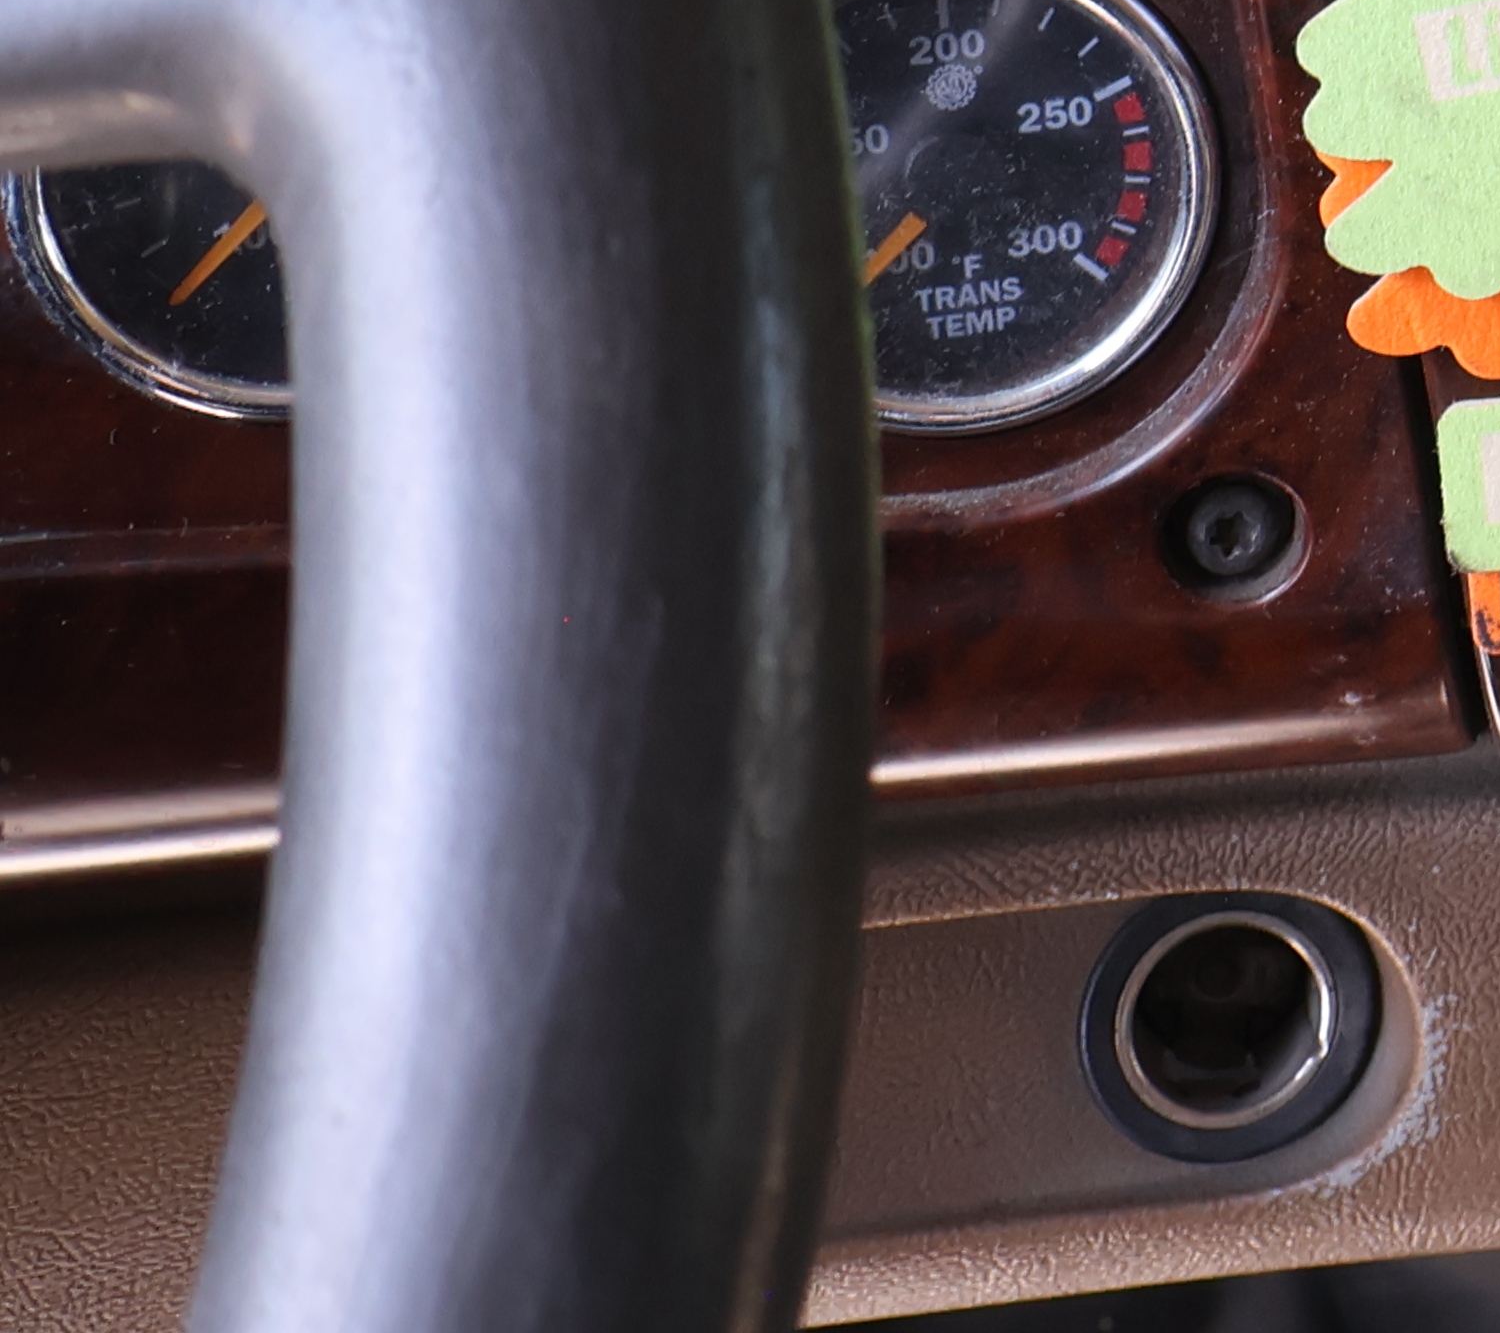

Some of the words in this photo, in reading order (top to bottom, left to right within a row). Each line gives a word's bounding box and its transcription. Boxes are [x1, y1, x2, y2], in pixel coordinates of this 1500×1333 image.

[908, 31, 985, 66] 200
[1016, 95, 1094, 133] 250
[850, 123, 890, 155] 50
[1007, 220, 1084, 259] 300
[916, 276, 1024, 313] TRANS
[925, 304, 1017, 341] TEMP
